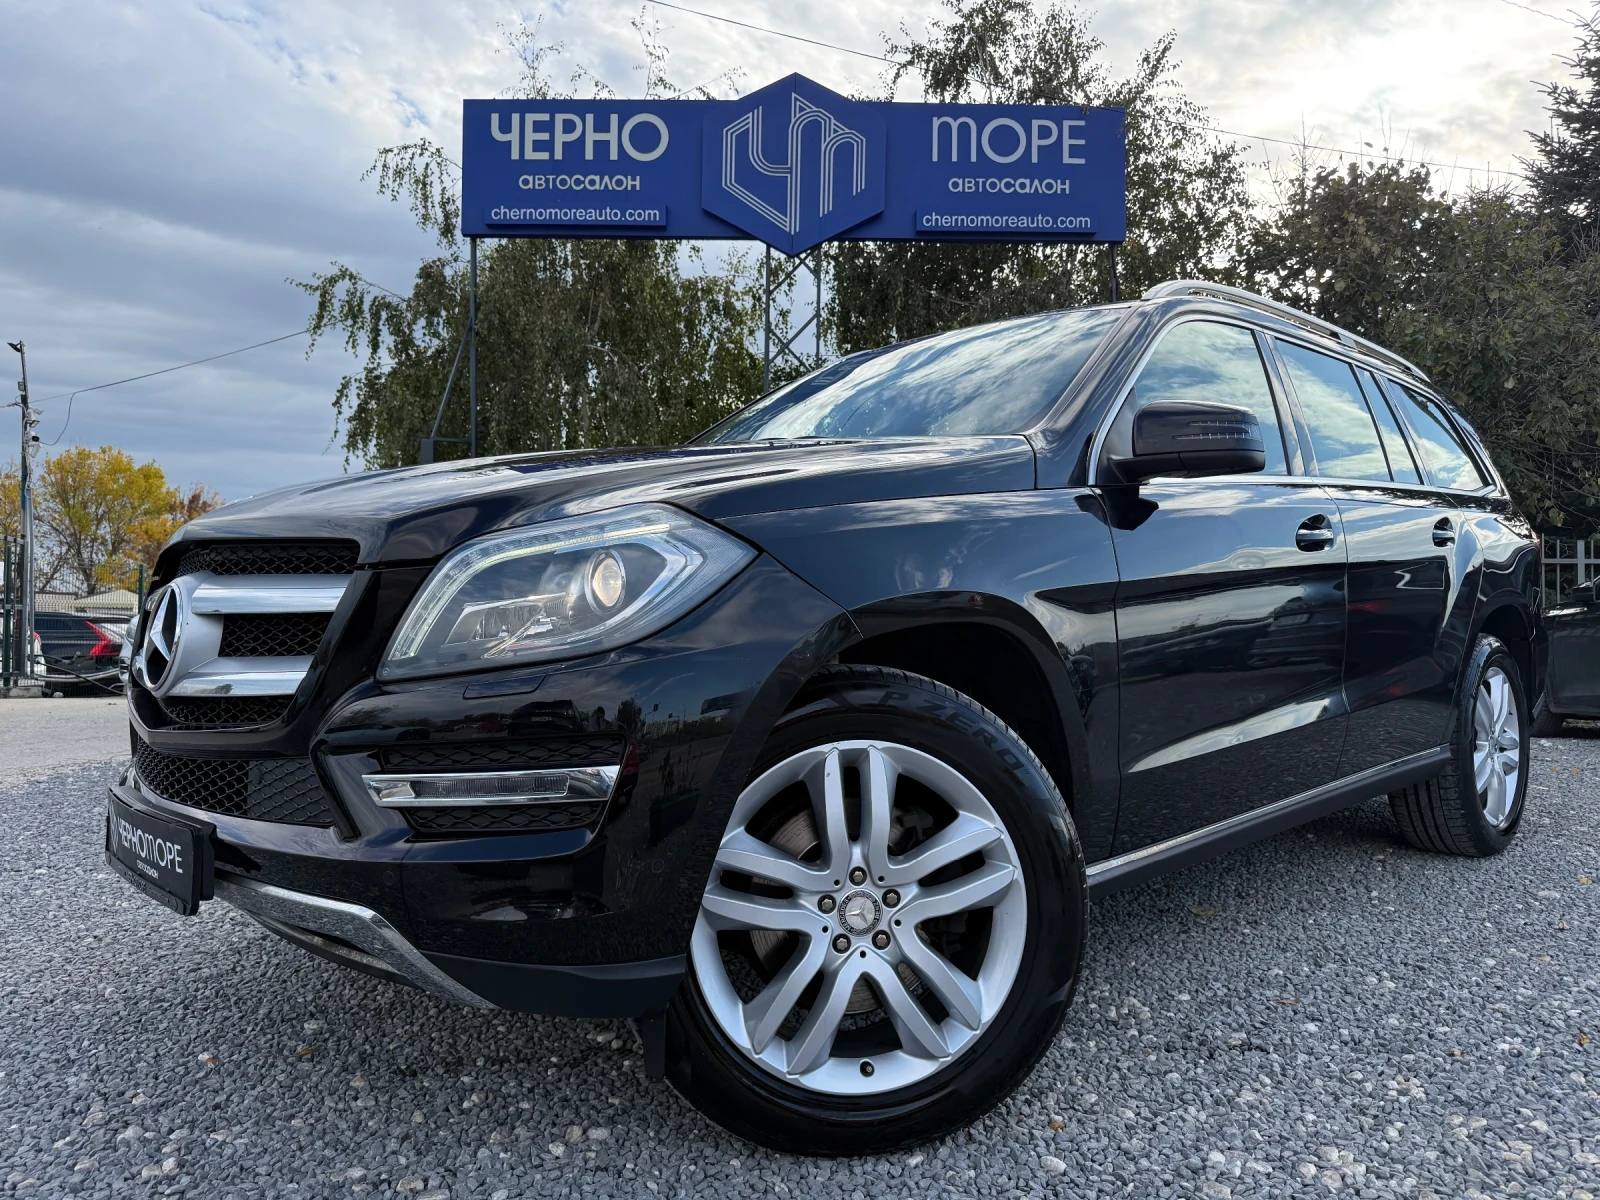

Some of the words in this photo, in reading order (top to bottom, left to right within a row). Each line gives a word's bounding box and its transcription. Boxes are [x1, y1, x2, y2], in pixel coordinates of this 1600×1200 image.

[490, 112, 669, 162] ЧЕРНО
[518, 174, 641, 191] автосалон
[948, 177, 1070, 195] автосалон
[491, 205, 660, 222] chernomoreauto.com
[922, 212, 1091, 229] chernomoreauto.com
[916, 699, 1025, 771] ZERO
